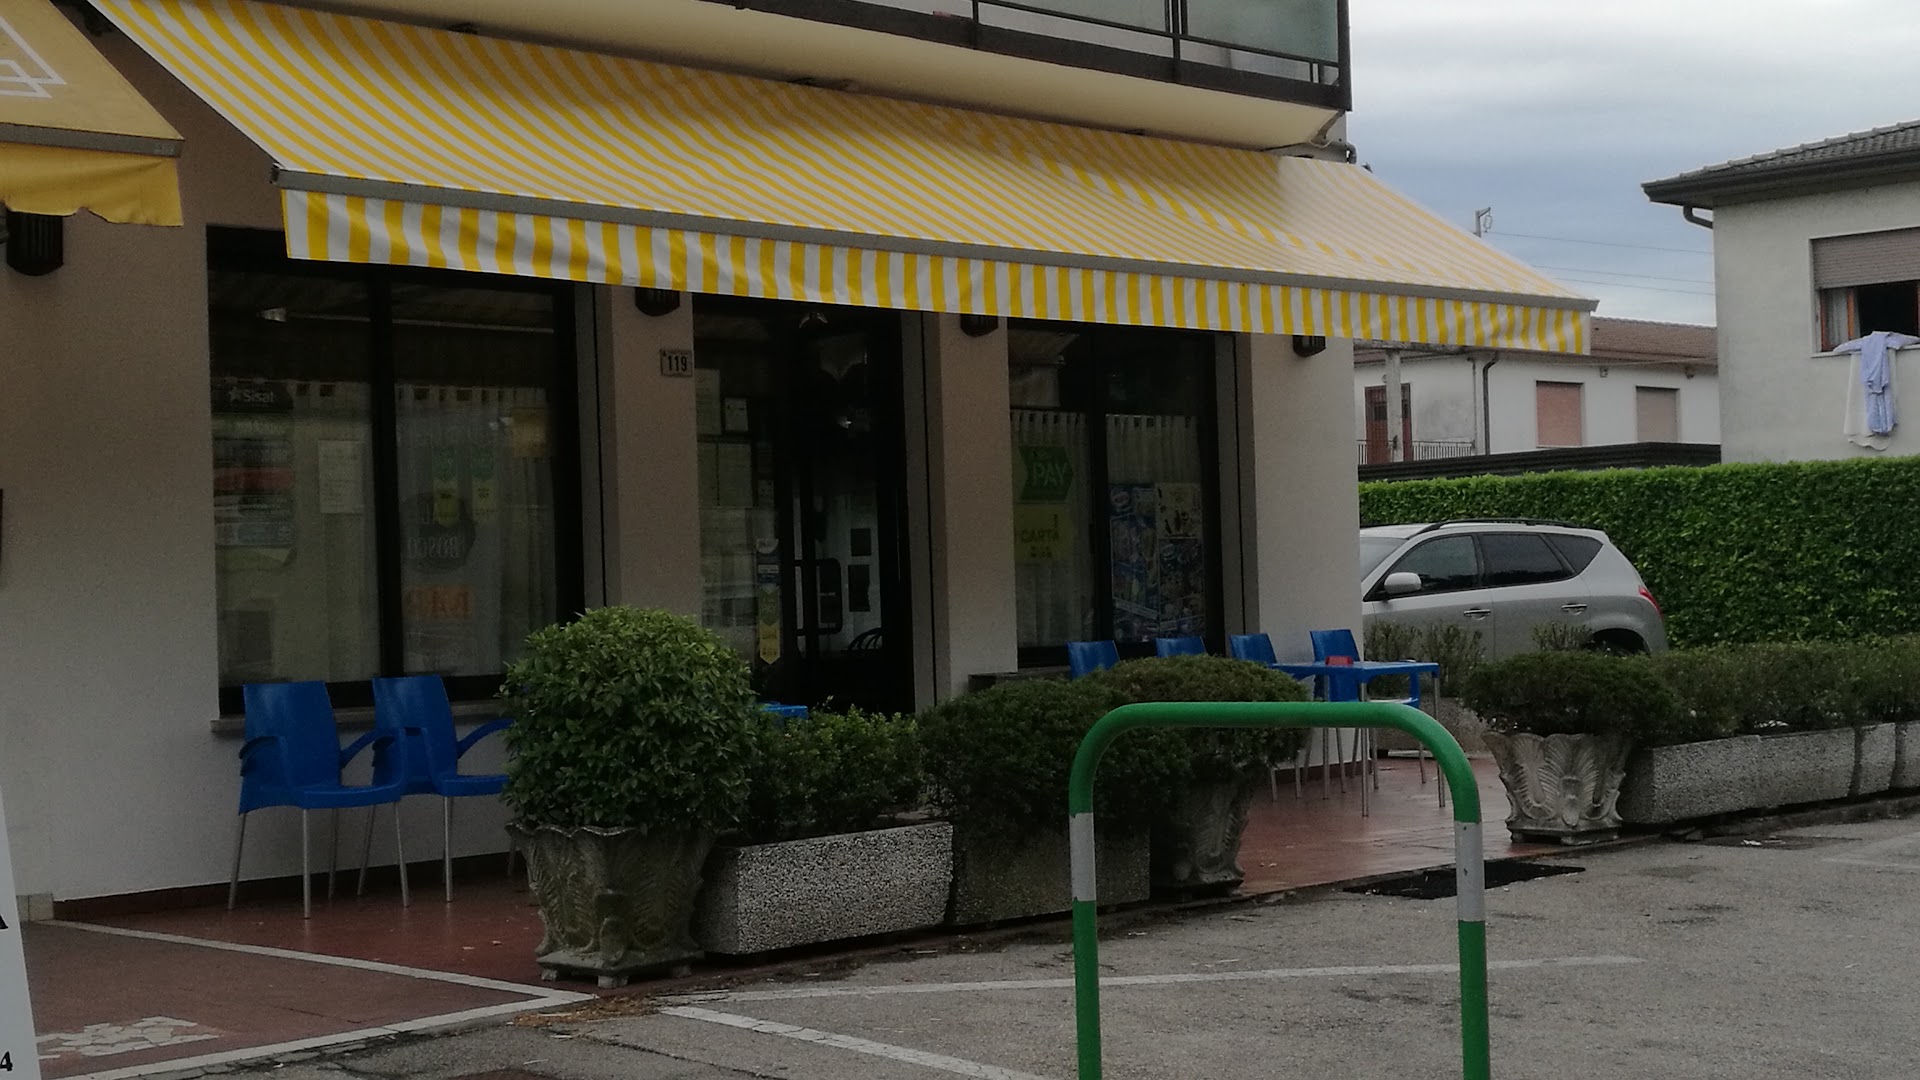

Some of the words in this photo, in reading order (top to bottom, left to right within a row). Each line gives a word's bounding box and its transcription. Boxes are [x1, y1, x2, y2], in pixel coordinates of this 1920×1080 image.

[668, 355, 687, 372] 119
[243, 389, 274, 403] Sisal
[1033, 462, 1067, 487] PAY
